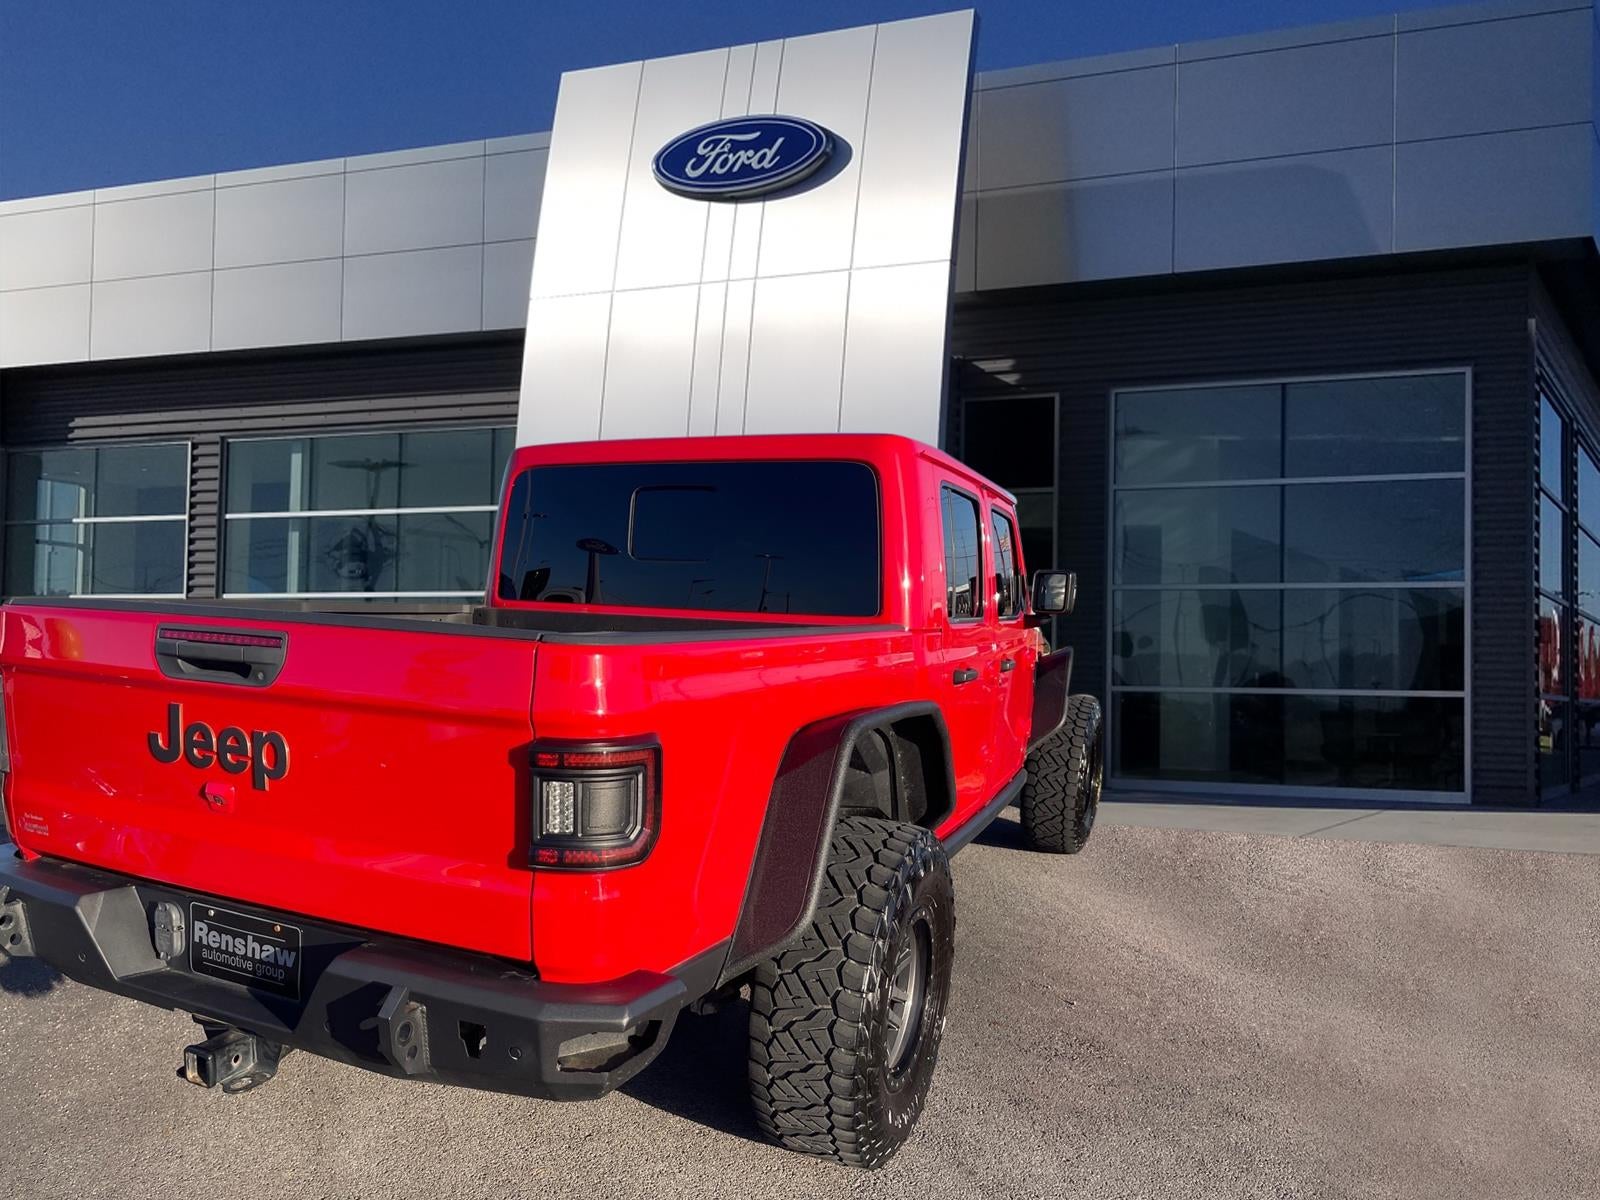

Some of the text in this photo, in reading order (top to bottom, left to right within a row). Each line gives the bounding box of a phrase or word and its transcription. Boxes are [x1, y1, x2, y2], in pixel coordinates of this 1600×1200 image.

[685, 131, 785, 178] Ford
[148, 702, 290, 791] Jeep
[194, 920, 296, 968] Renshaw
[202, 948, 285, 980] automotive group
